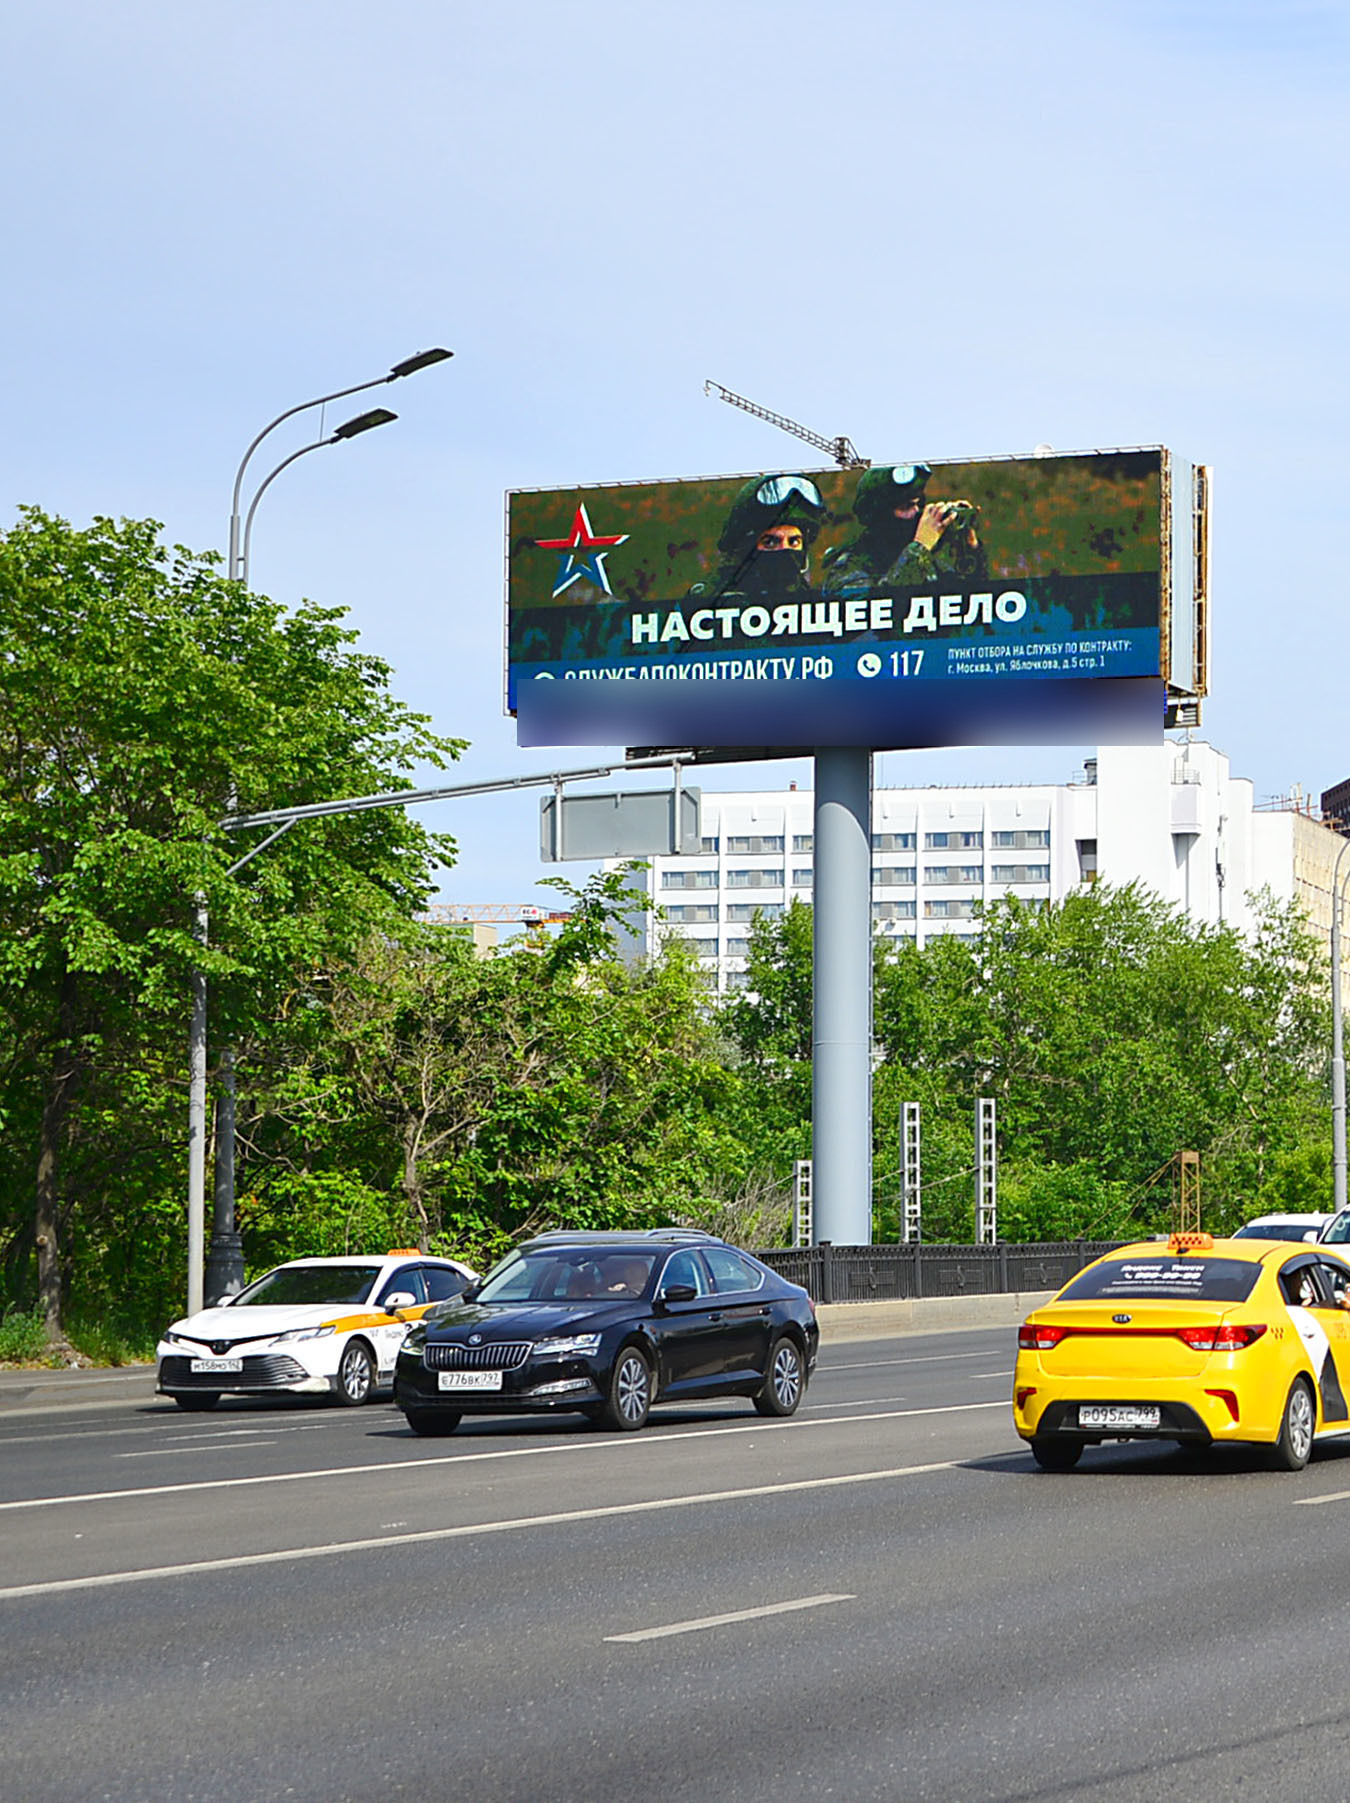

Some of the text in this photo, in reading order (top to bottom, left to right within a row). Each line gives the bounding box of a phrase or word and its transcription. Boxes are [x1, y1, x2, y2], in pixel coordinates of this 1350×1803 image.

[632, 591, 1027, 644] НАСТОЯЩЕЕ ДЕЛО
[948, 639, 1132, 660] ПУНКТ ОТБОРА НА СЛУЖБУ ПО КОНТРАКТУ:
[890, 650, 925, 677] 117
[956, 662, 993, 675] Москва,
[995, 662, 1008, 674] ул.
[1010, 659, 1061, 672] Яблочкова,
